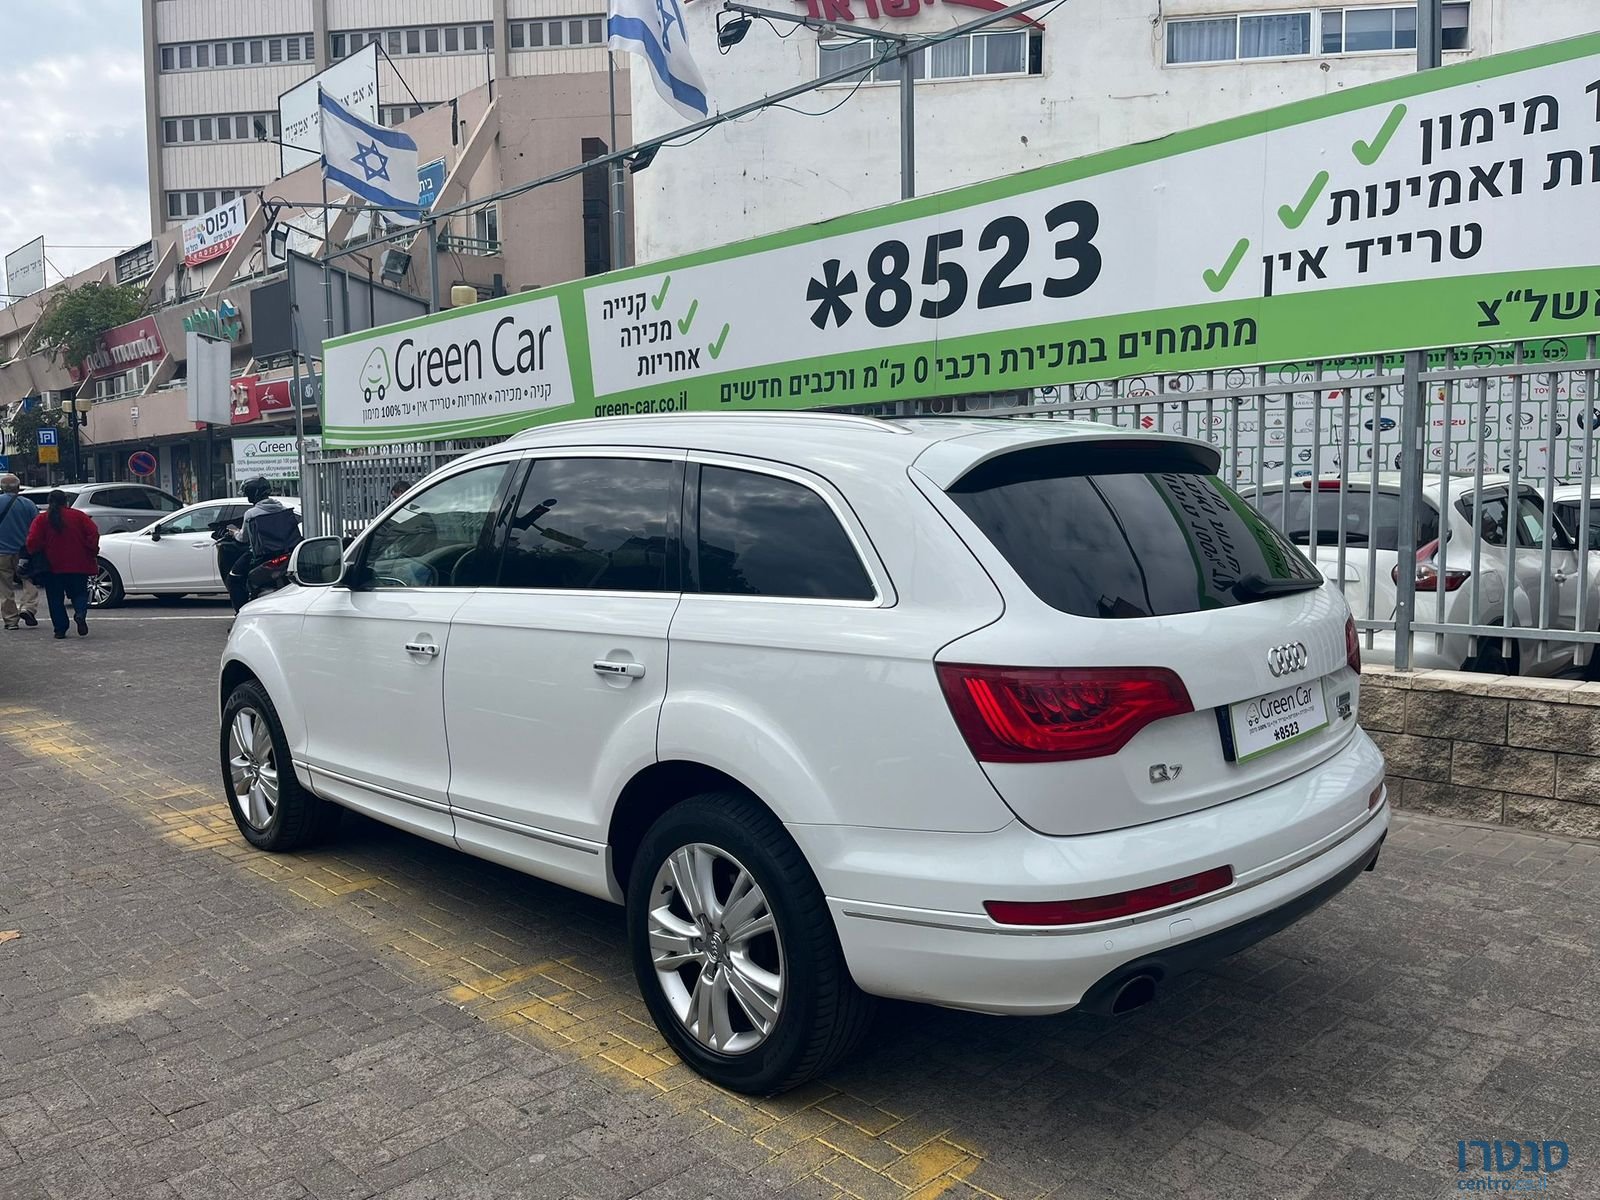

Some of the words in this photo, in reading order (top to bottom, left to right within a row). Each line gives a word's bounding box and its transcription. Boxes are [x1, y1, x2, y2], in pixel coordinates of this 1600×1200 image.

[1420, 95, 1559, 165] מימון
[1326, 158, 1523, 226] ואמינות
[206, 206, 236, 235] דפוס
[1345, 222, 1483, 274] טרייד
[1262, 246, 1329, 297] אין
[603, 292, 646, 320] קנייה
[621, 320, 672, 347] מכירה
[1118, 317, 1257, 359] מתמחים
[395, 338, 482, 392] Green
[491, 316, 552, 376] Car
[637, 348, 701, 377] אחריות
[935, 352, 990, 381] רכבי
[998, 337, 1107, 374] במכירת
[789, 369, 854, 395] ורכבים
[913, 356, 929, 383] 0
[457, 391, 487, 408] אחריות
[494, 387, 522, 401] מכירה
[530, 383, 552, 401] קניה
[595, 390, 687, 417] green-car.co.il
[720, 377, 782, 403] חדשים
[362, 406, 380, 424] מימון
[381, 404, 401, 418] 100%
[401, 403, 411, 415] עד
[259, 441, 292, 453] Green
[1260, 695, 1296, 718] Green
[1296, 686, 1312, 706] Car
[1149, 763, 1183, 784] Q7
